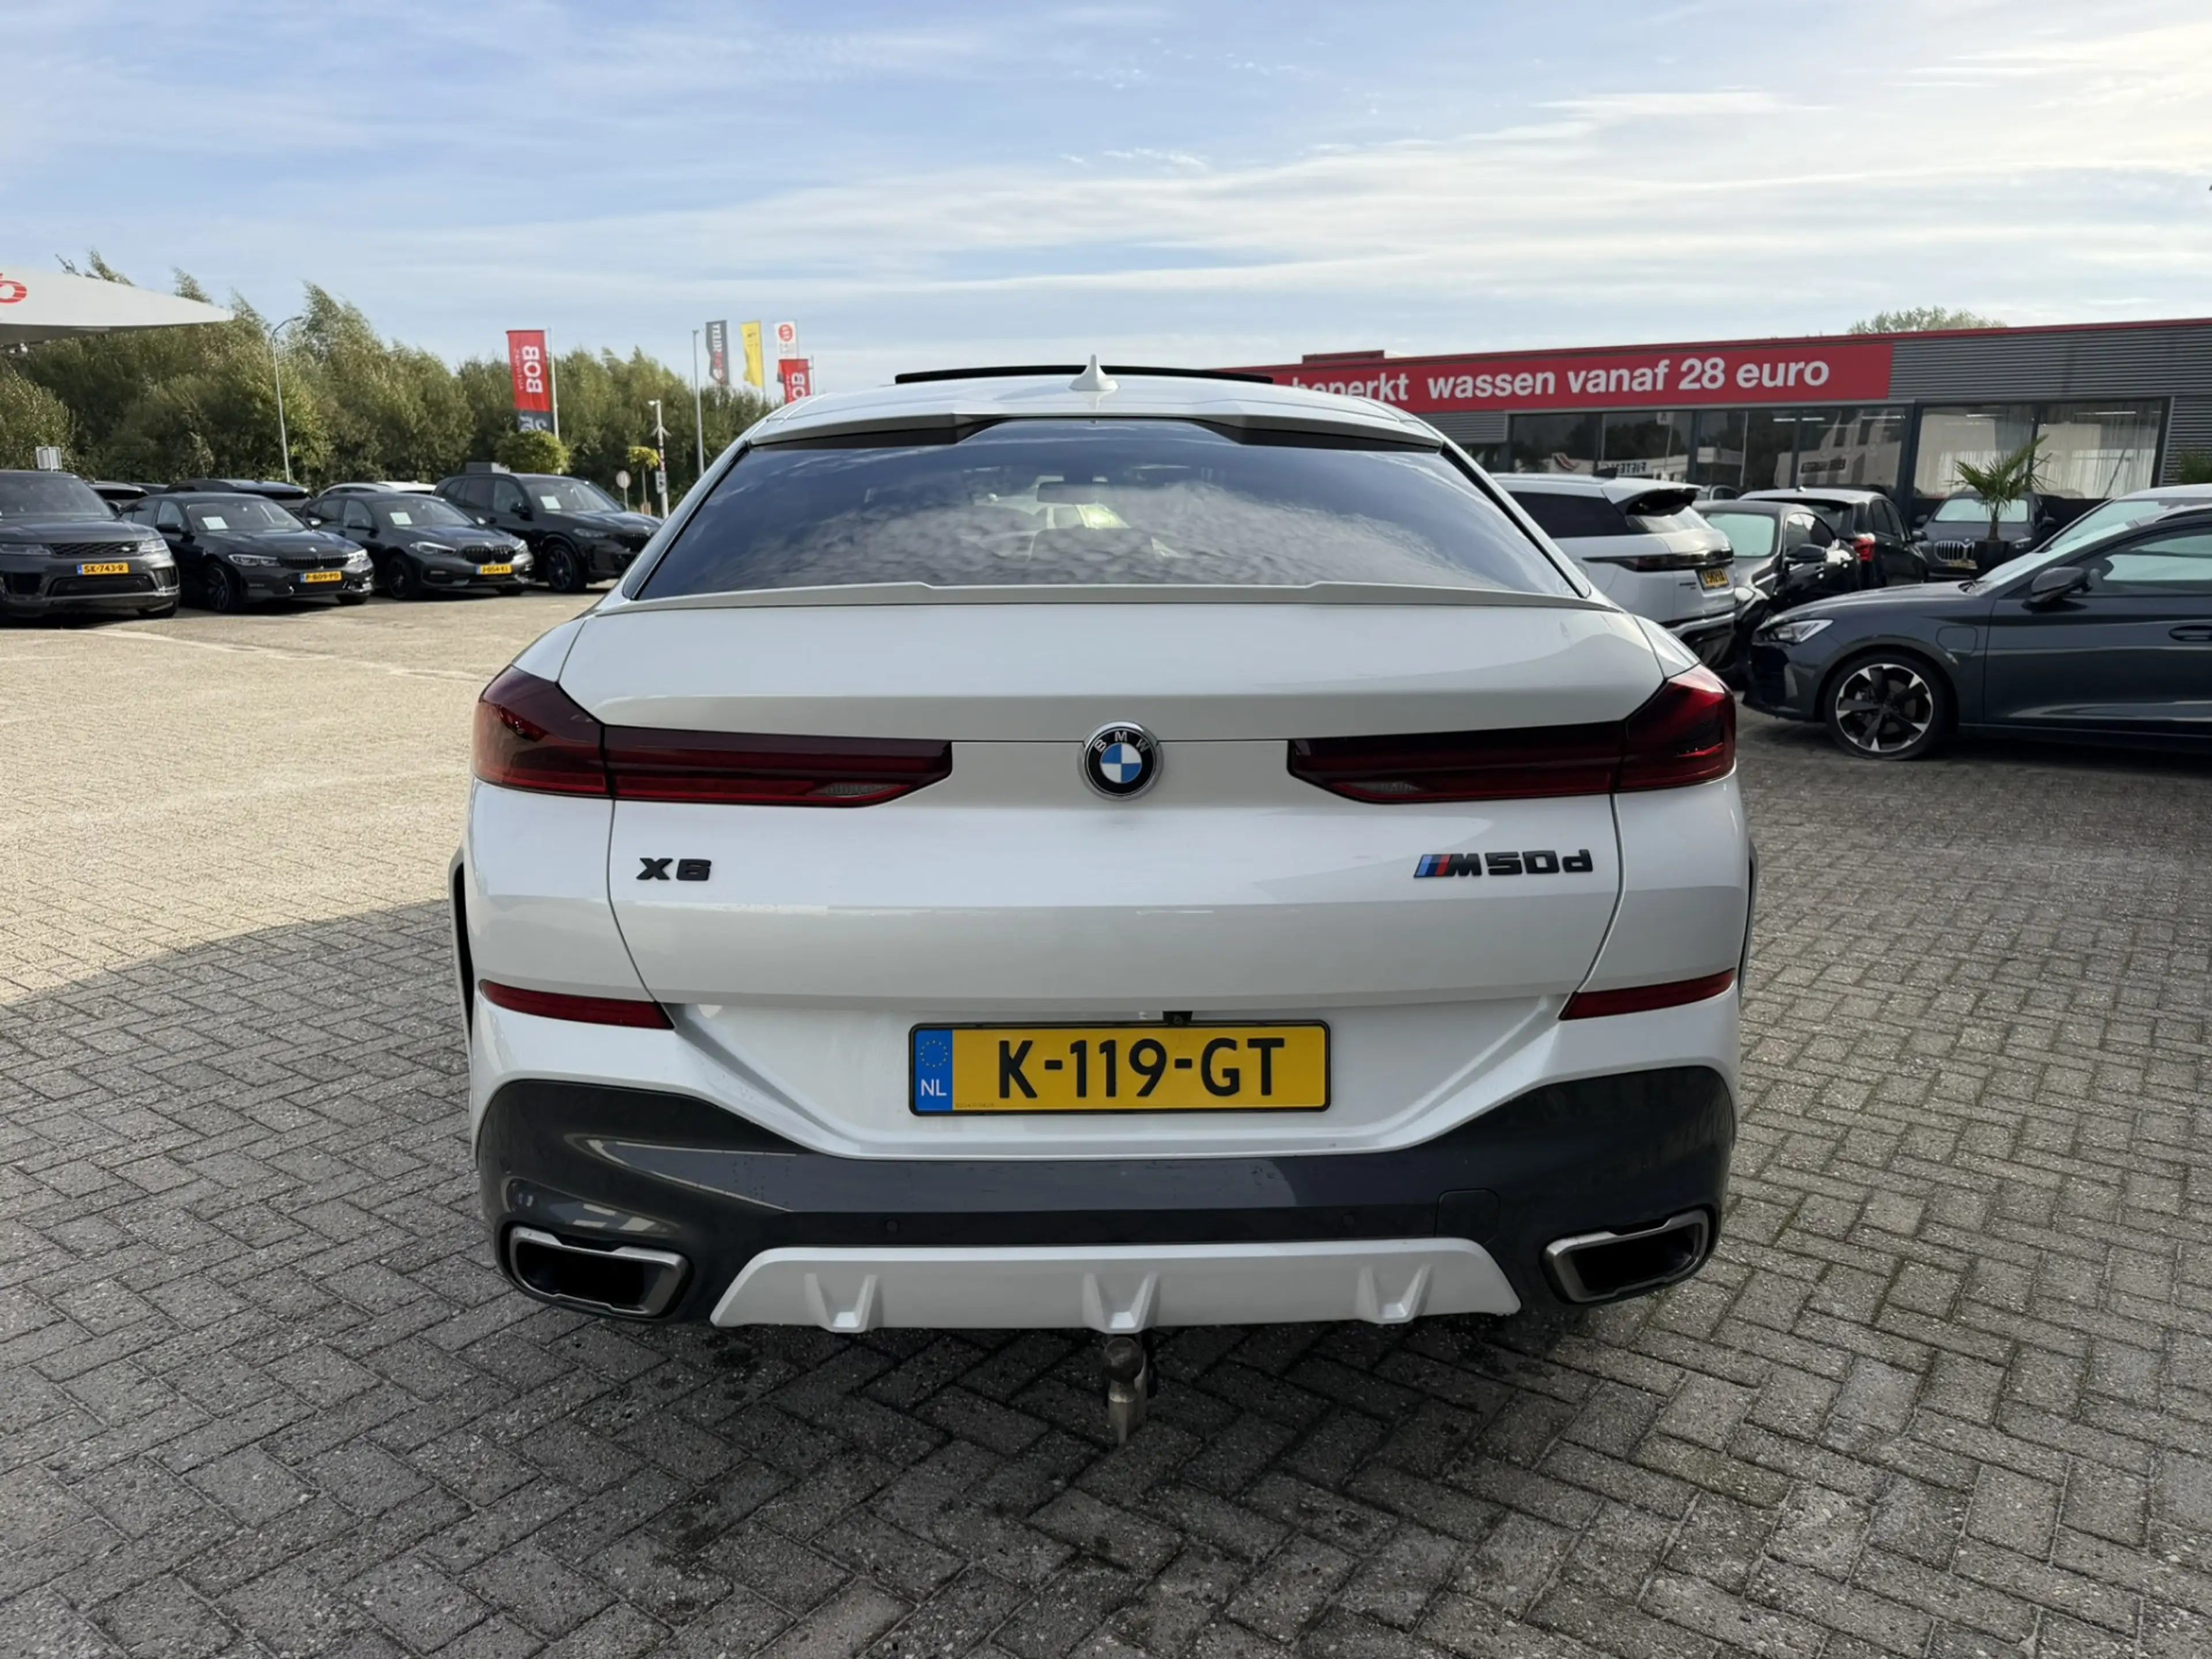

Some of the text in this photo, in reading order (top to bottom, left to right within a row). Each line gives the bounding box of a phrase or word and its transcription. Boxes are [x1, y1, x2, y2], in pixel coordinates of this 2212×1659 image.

[522, 345, 543, 393] BOB
[1427, 371, 1555, 399] wassen
[1567, 359, 1670, 393] vanaf
[1679, 357, 1726, 391] 28
[1736, 360, 1830, 388] euro
[1093, 732, 1150, 753] BMW
[636, 858, 711, 881] X6
[998, 1037, 1285, 1099] K-119-GT
[921, 1080, 946, 1096] NL
